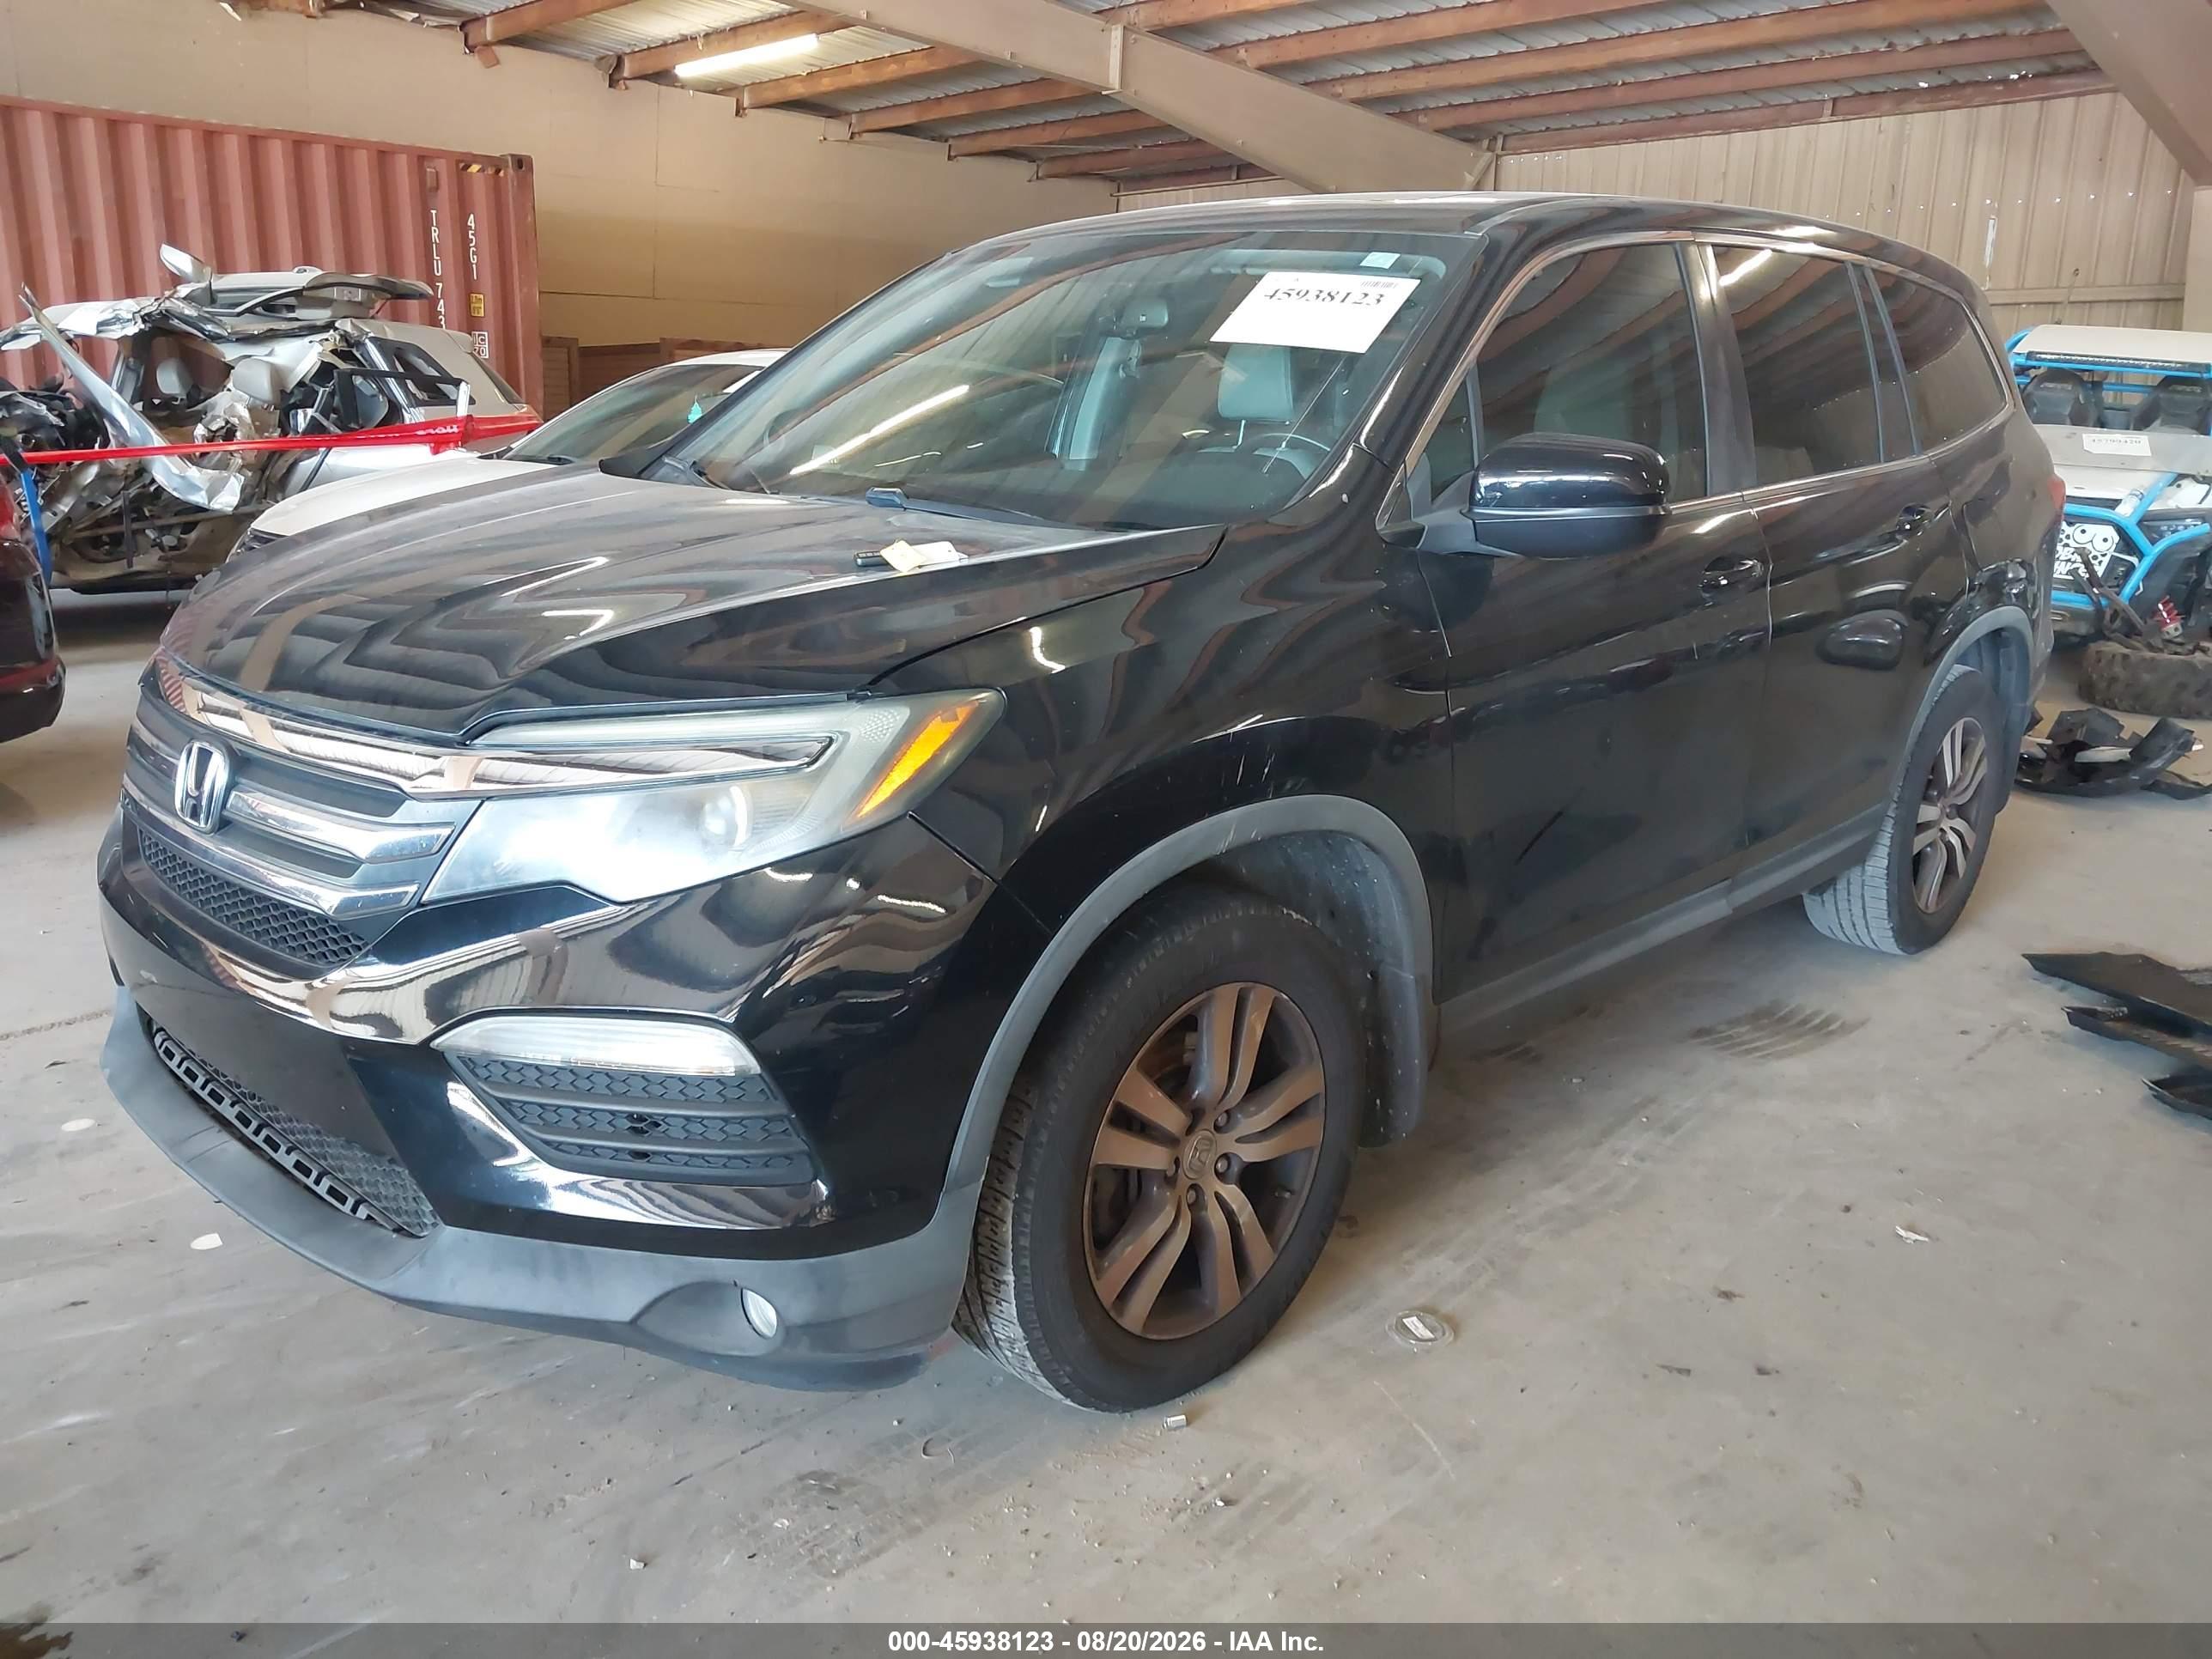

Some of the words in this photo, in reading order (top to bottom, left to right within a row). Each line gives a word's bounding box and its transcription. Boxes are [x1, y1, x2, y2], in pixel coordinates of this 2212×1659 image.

[430, 210, 441, 276] TRLU
[467, 213, 477, 280] 45G1
[1263, 288, 1385, 306] 45938123
